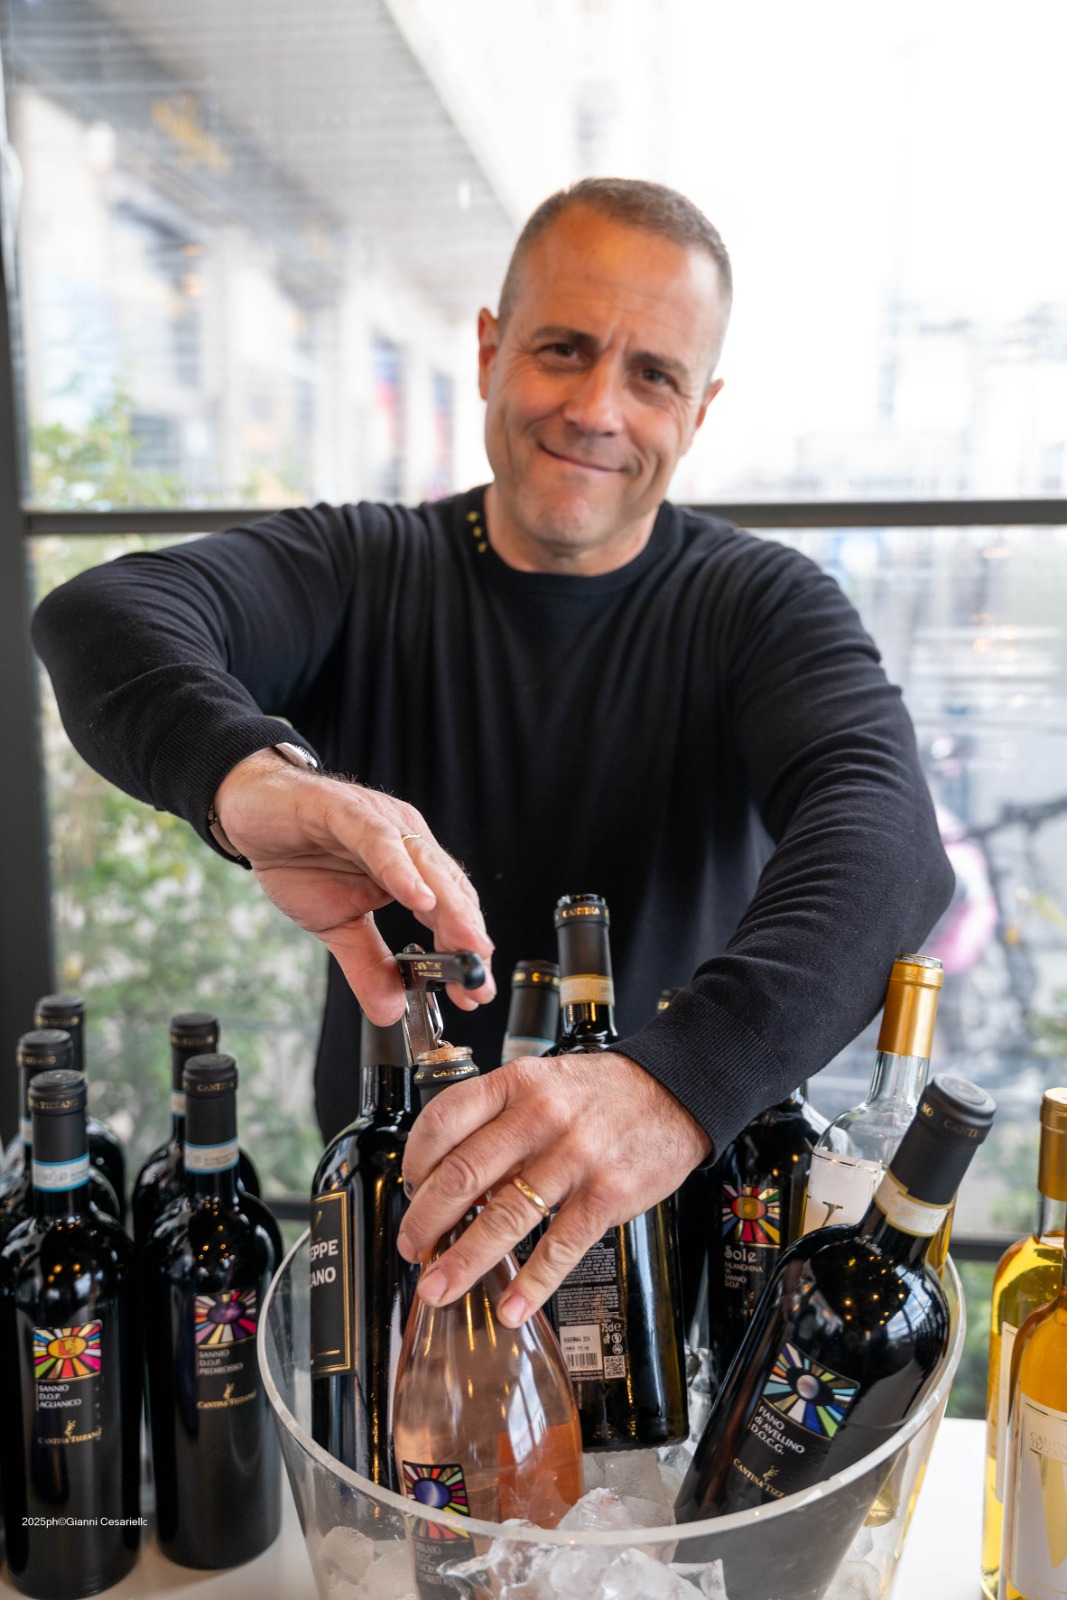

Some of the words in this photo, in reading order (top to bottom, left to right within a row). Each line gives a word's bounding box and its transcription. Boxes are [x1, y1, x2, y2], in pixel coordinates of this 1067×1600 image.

[724, 1244, 757, 1263] Sole
[199, 1349, 230, 1359] SANNIO
[38, 1384, 70, 1392] SANNIO
[39, 1398, 82, 1408] AGLIANICO
[759, 1405, 785, 1431] FIANO
[750, 1423, 785, 1456] D.O.C.G.
[754, 1415, 763, 1425] di
[762, 1423, 806, 1455] AVELLINO
[733, 1458, 764, 1488] CANTINA
